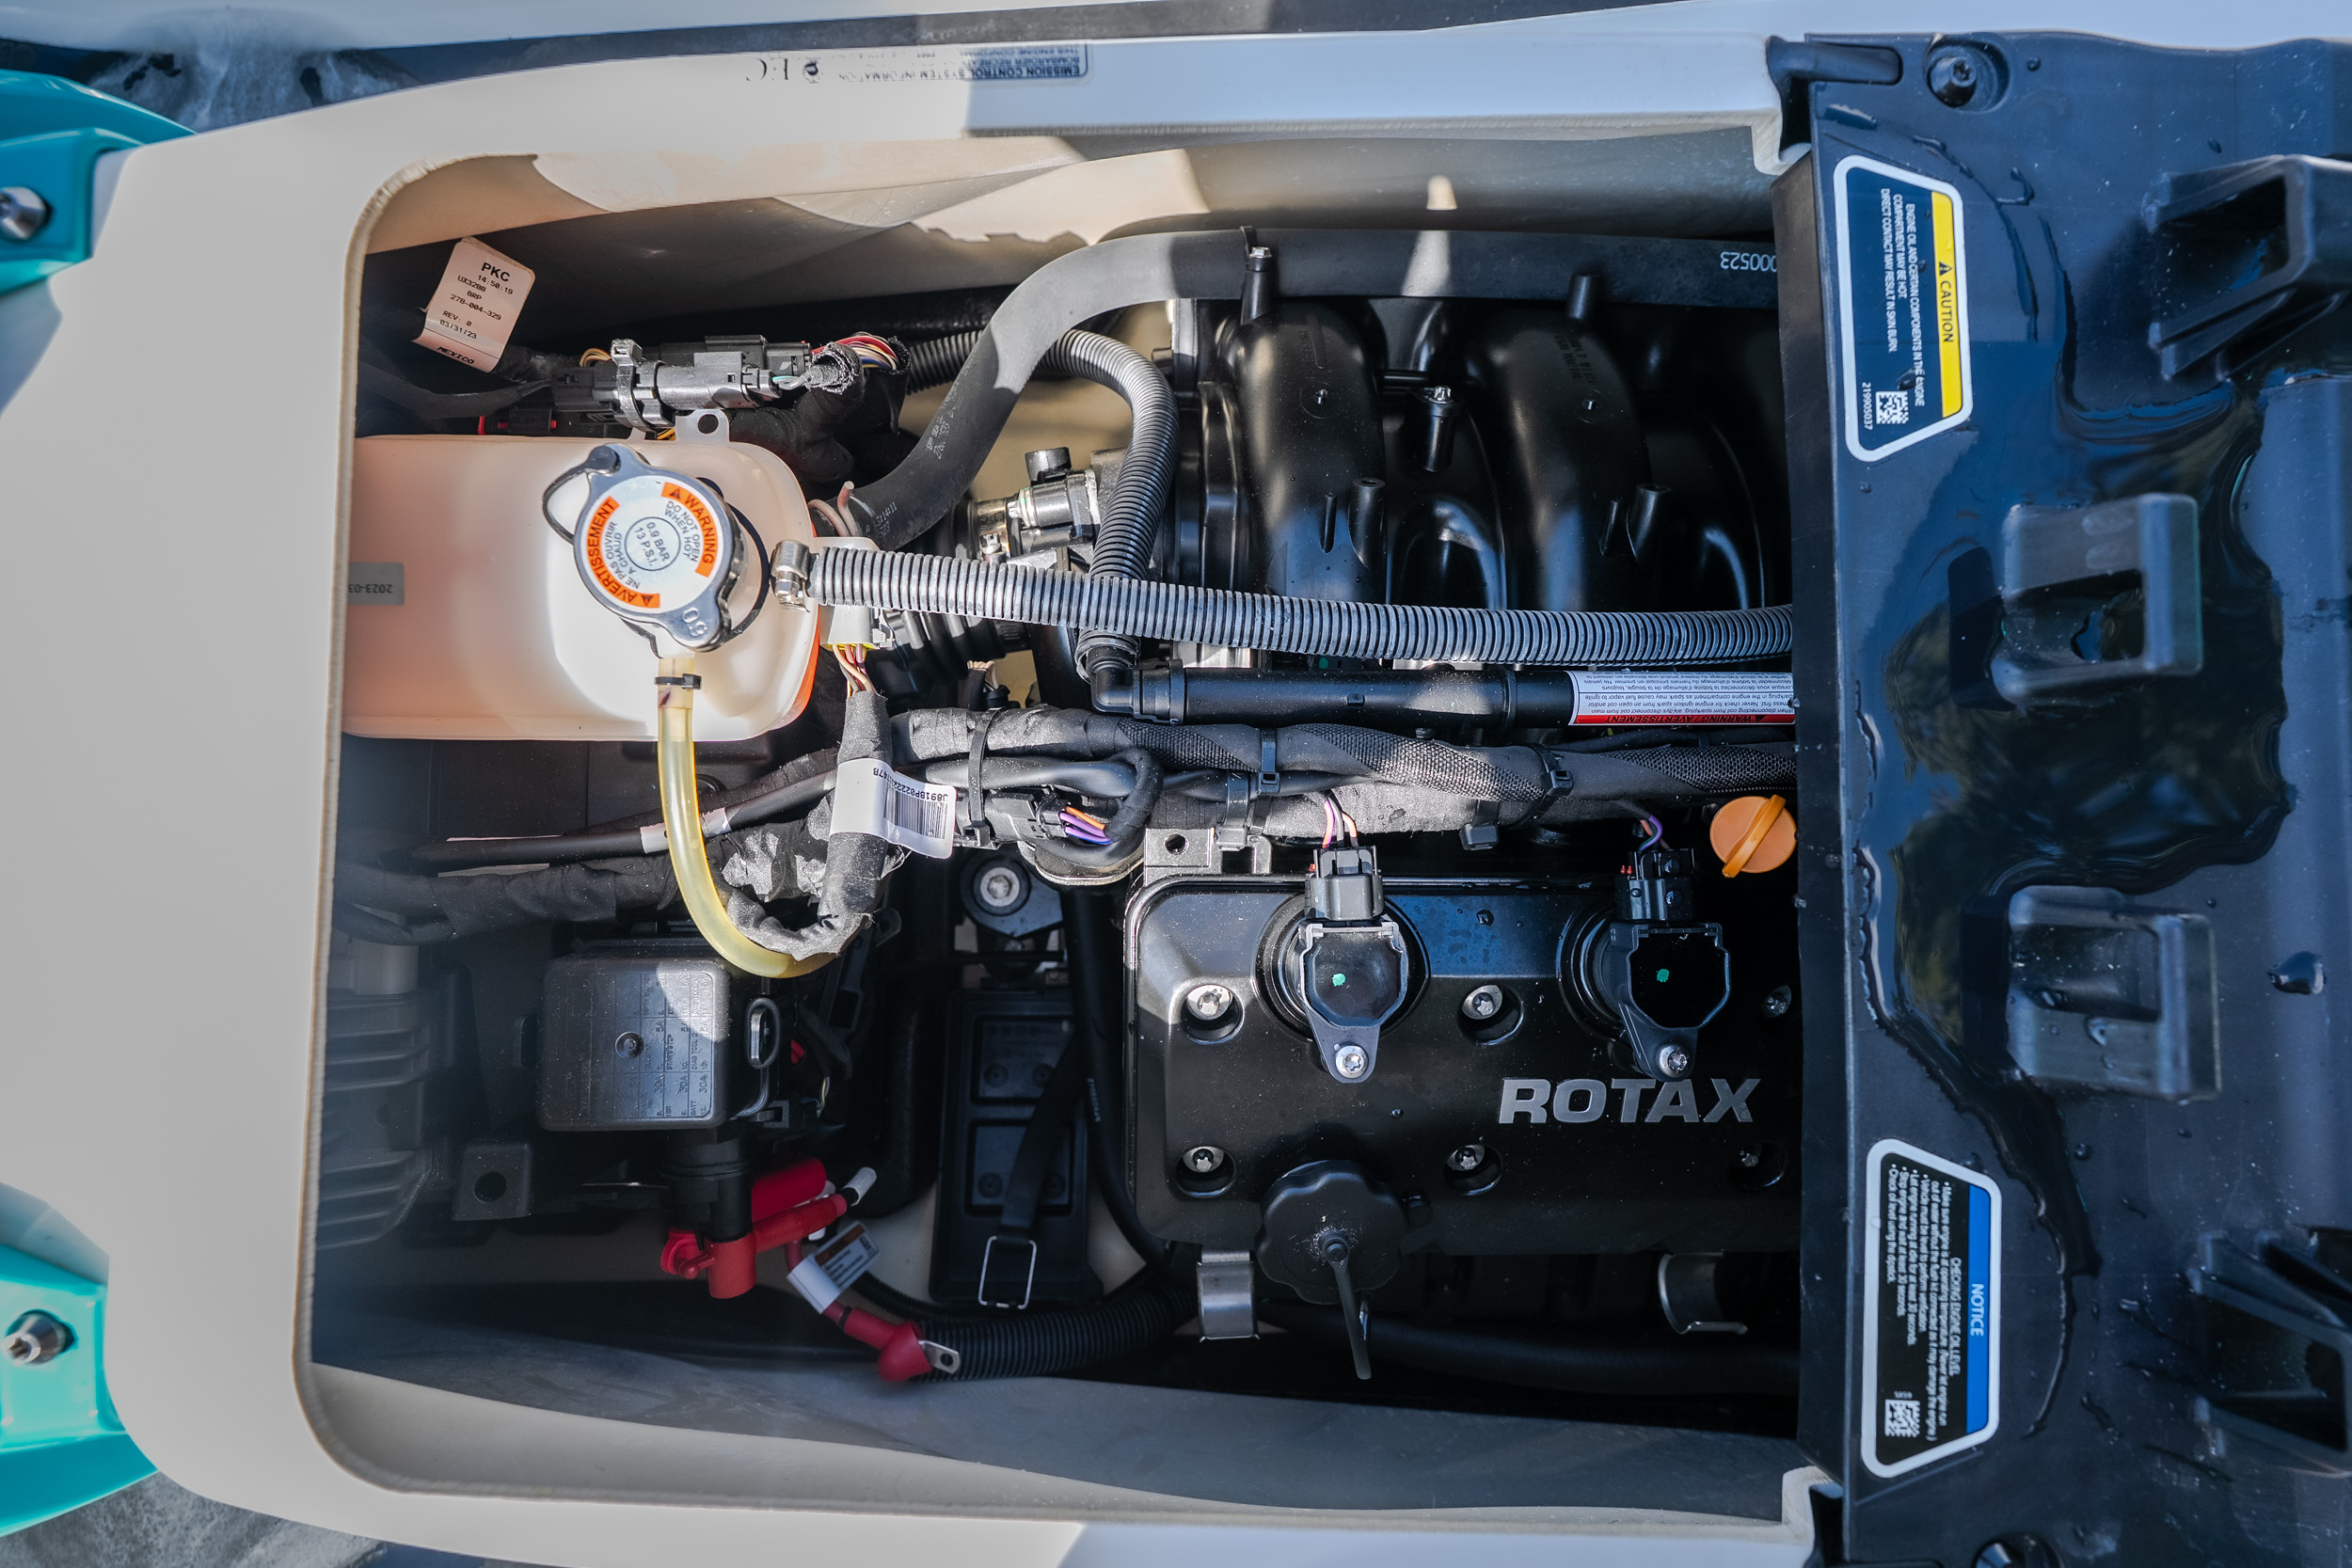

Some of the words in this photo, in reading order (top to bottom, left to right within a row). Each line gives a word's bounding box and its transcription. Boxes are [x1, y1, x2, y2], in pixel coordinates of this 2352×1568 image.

[1014, 56, 1079, 66] BOMBARDIER
[1026, 66, 1079, 77] EMISSION
[920, 69, 964, 80] SYSTEM
[969, 67, 1022, 78] CONTROL
[1880, 187, 1891, 216] DIRECT
[1892, 193, 1905, 251] COMPARTMENT
[1905, 203, 1916, 232] ENGINE
[1881, 216, 1893, 254] CONTACT
[1906, 232, 1916, 245] OIL
[1720, 249, 1778, 274] 000523
[1883, 253, 1893, 270] MAY
[1896, 252, 1906, 269] MAY
[1907, 245, 1917, 263] AND
[480, 261, 511, 282] PKC
[1896, 269, 1906, 280] BE
[1907, 263, 1919, 296] CERTAIN
[477, 275, 513, 294] 14:50:19
[1883, 270, 1895, 300] RESULT
[1897, 280, 1907, 299] HOT.
[466, 290, 482, 301] BRP
[1885, 300, 1895, 309] IN
[442, 309, 461, 322] REV:
[450, 293, 501, 321] 278-004-329
[1939, 279, 1954, 342] CAUTION
[438, 318, 477, 340] 03/31/23
[1885, 309, 1897, 328] SKIN
[1909, 296, 1922, 351] COMPONENTS
[1886, 328, 1898, 353] BURN.
[437, 344, 474, 365] MEXICO
[1913, 351, 1922, 359] IN
[1913, 360, 1925, 375] THE
[1913, 375, 1925, 406] ENGINE
[1860, 381, 1873, 430] 219905037
[646, 521, 660, 537] 0.9
[664, 508, 690, 533] WHEN
[683, 536, 691, 558] HOT
[666, 500, 681, 513] DO
[682, 510, 698, 531] NOT
[691, 533, 700, 562] OPEN
[684, 495, 714, 564] WARNING
[603, 521, 617, 560] OUVRIR
[613, 532, 628, 567] CHAUD
[633, 527, 646, 540] 13
[641, 540, 658, 566] P.S.I.
[587, 500, 635, 603] AVERTISSEMENT
[609, 559, 626, 579] PAS
[347, 582, 393, 595] 2023-03
[625, 576, 640, 589] NE
[655, 1020, 663, 1032] 5A
[678, 1074, 687, 1092] 30A
[698, 1075, 707, 1093] 30A
[1498, 1078, 1761, 1123] ROTAX
[1949, 1257, 1963, 1301] CHECKING
[1949, 1301, 1961, 1334] ENGINE
[1969, 1283, 1985, 1336] NOTICE
[1949, 1334, 1961, 1349] OIL
[1948, 1349, 1961, 1376] LEVEL
